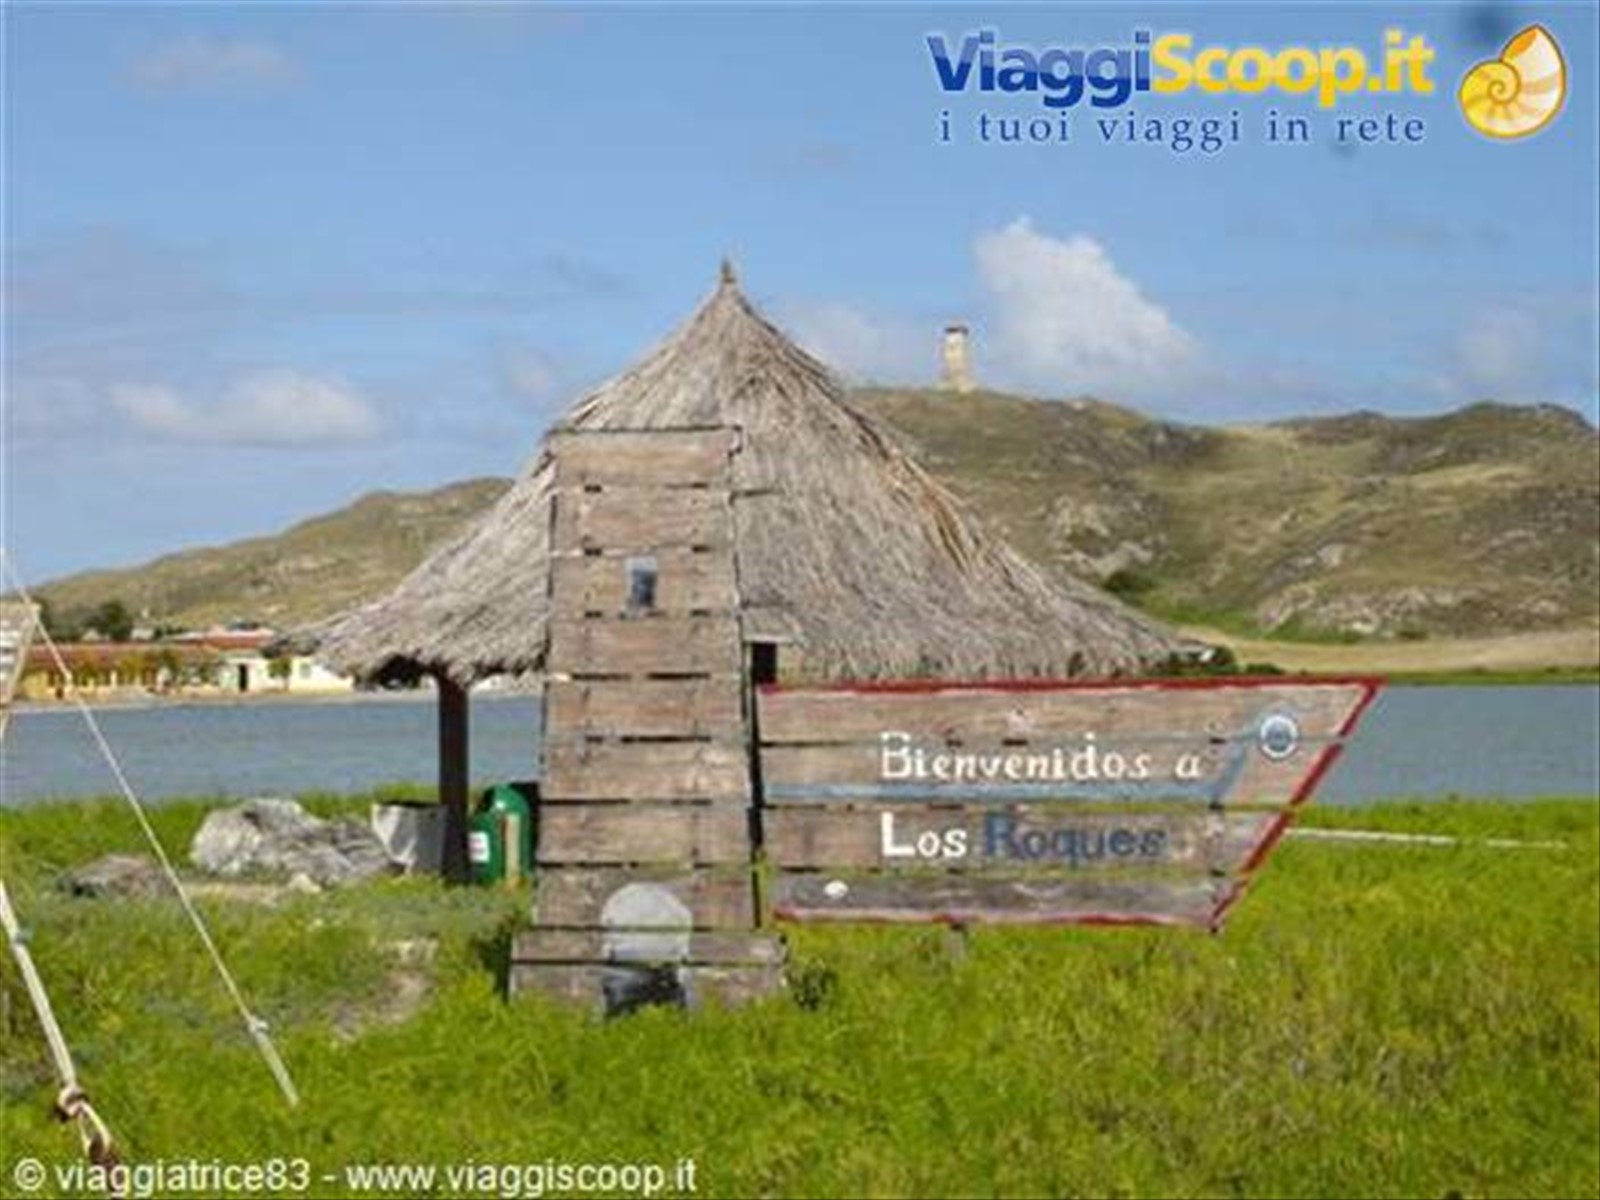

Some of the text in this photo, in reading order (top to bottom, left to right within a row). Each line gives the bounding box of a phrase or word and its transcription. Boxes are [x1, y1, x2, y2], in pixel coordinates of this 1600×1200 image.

[881, 732, 1201, 779] Bienvenidos a
[880, 812, 1165, 863] Los Roques
